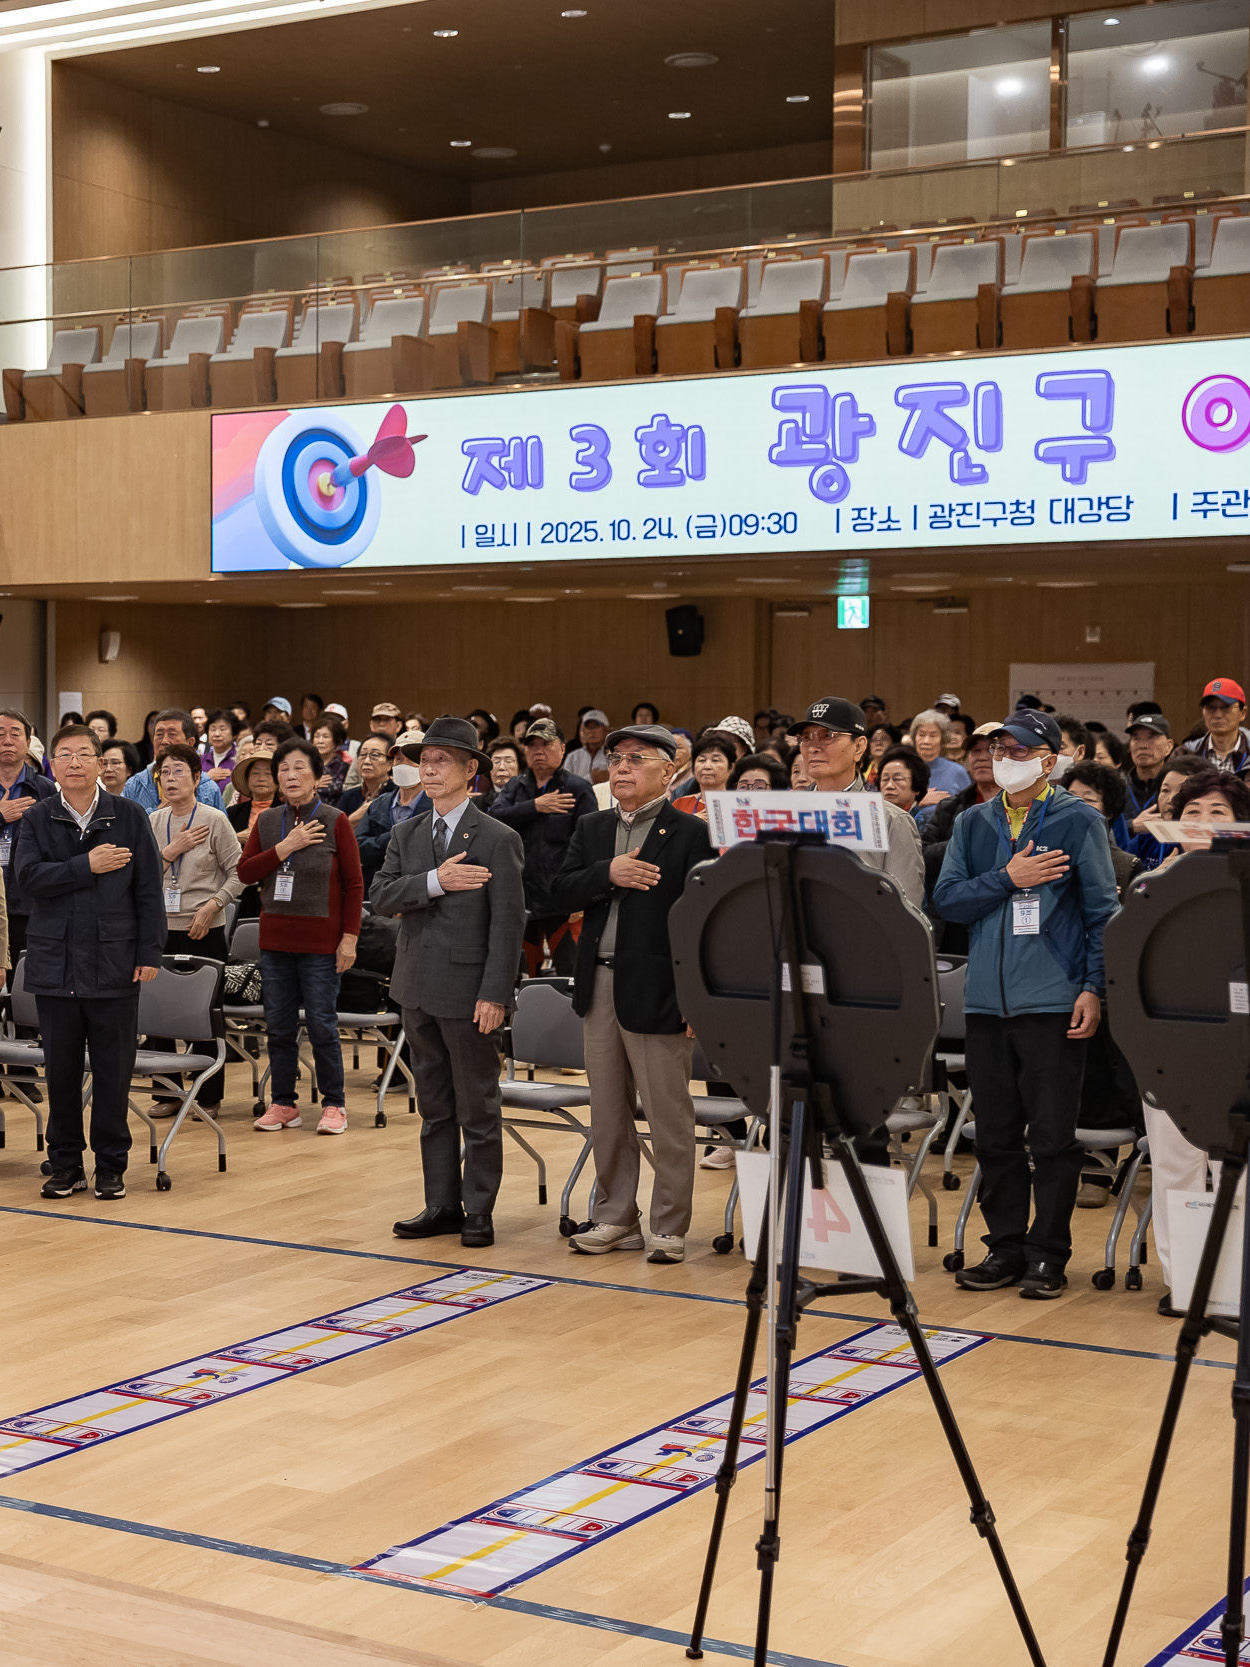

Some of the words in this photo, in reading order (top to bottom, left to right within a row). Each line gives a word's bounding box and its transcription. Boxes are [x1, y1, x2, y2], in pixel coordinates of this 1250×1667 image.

[474, 524, 518, 548] 일시
[850, 506, 902, 533] 장소
[928, 499, 1036, 530] 광진구청
[1049, 495, 1135, 525] 대강당
[732, 808, 863, 841] 한궁대회
